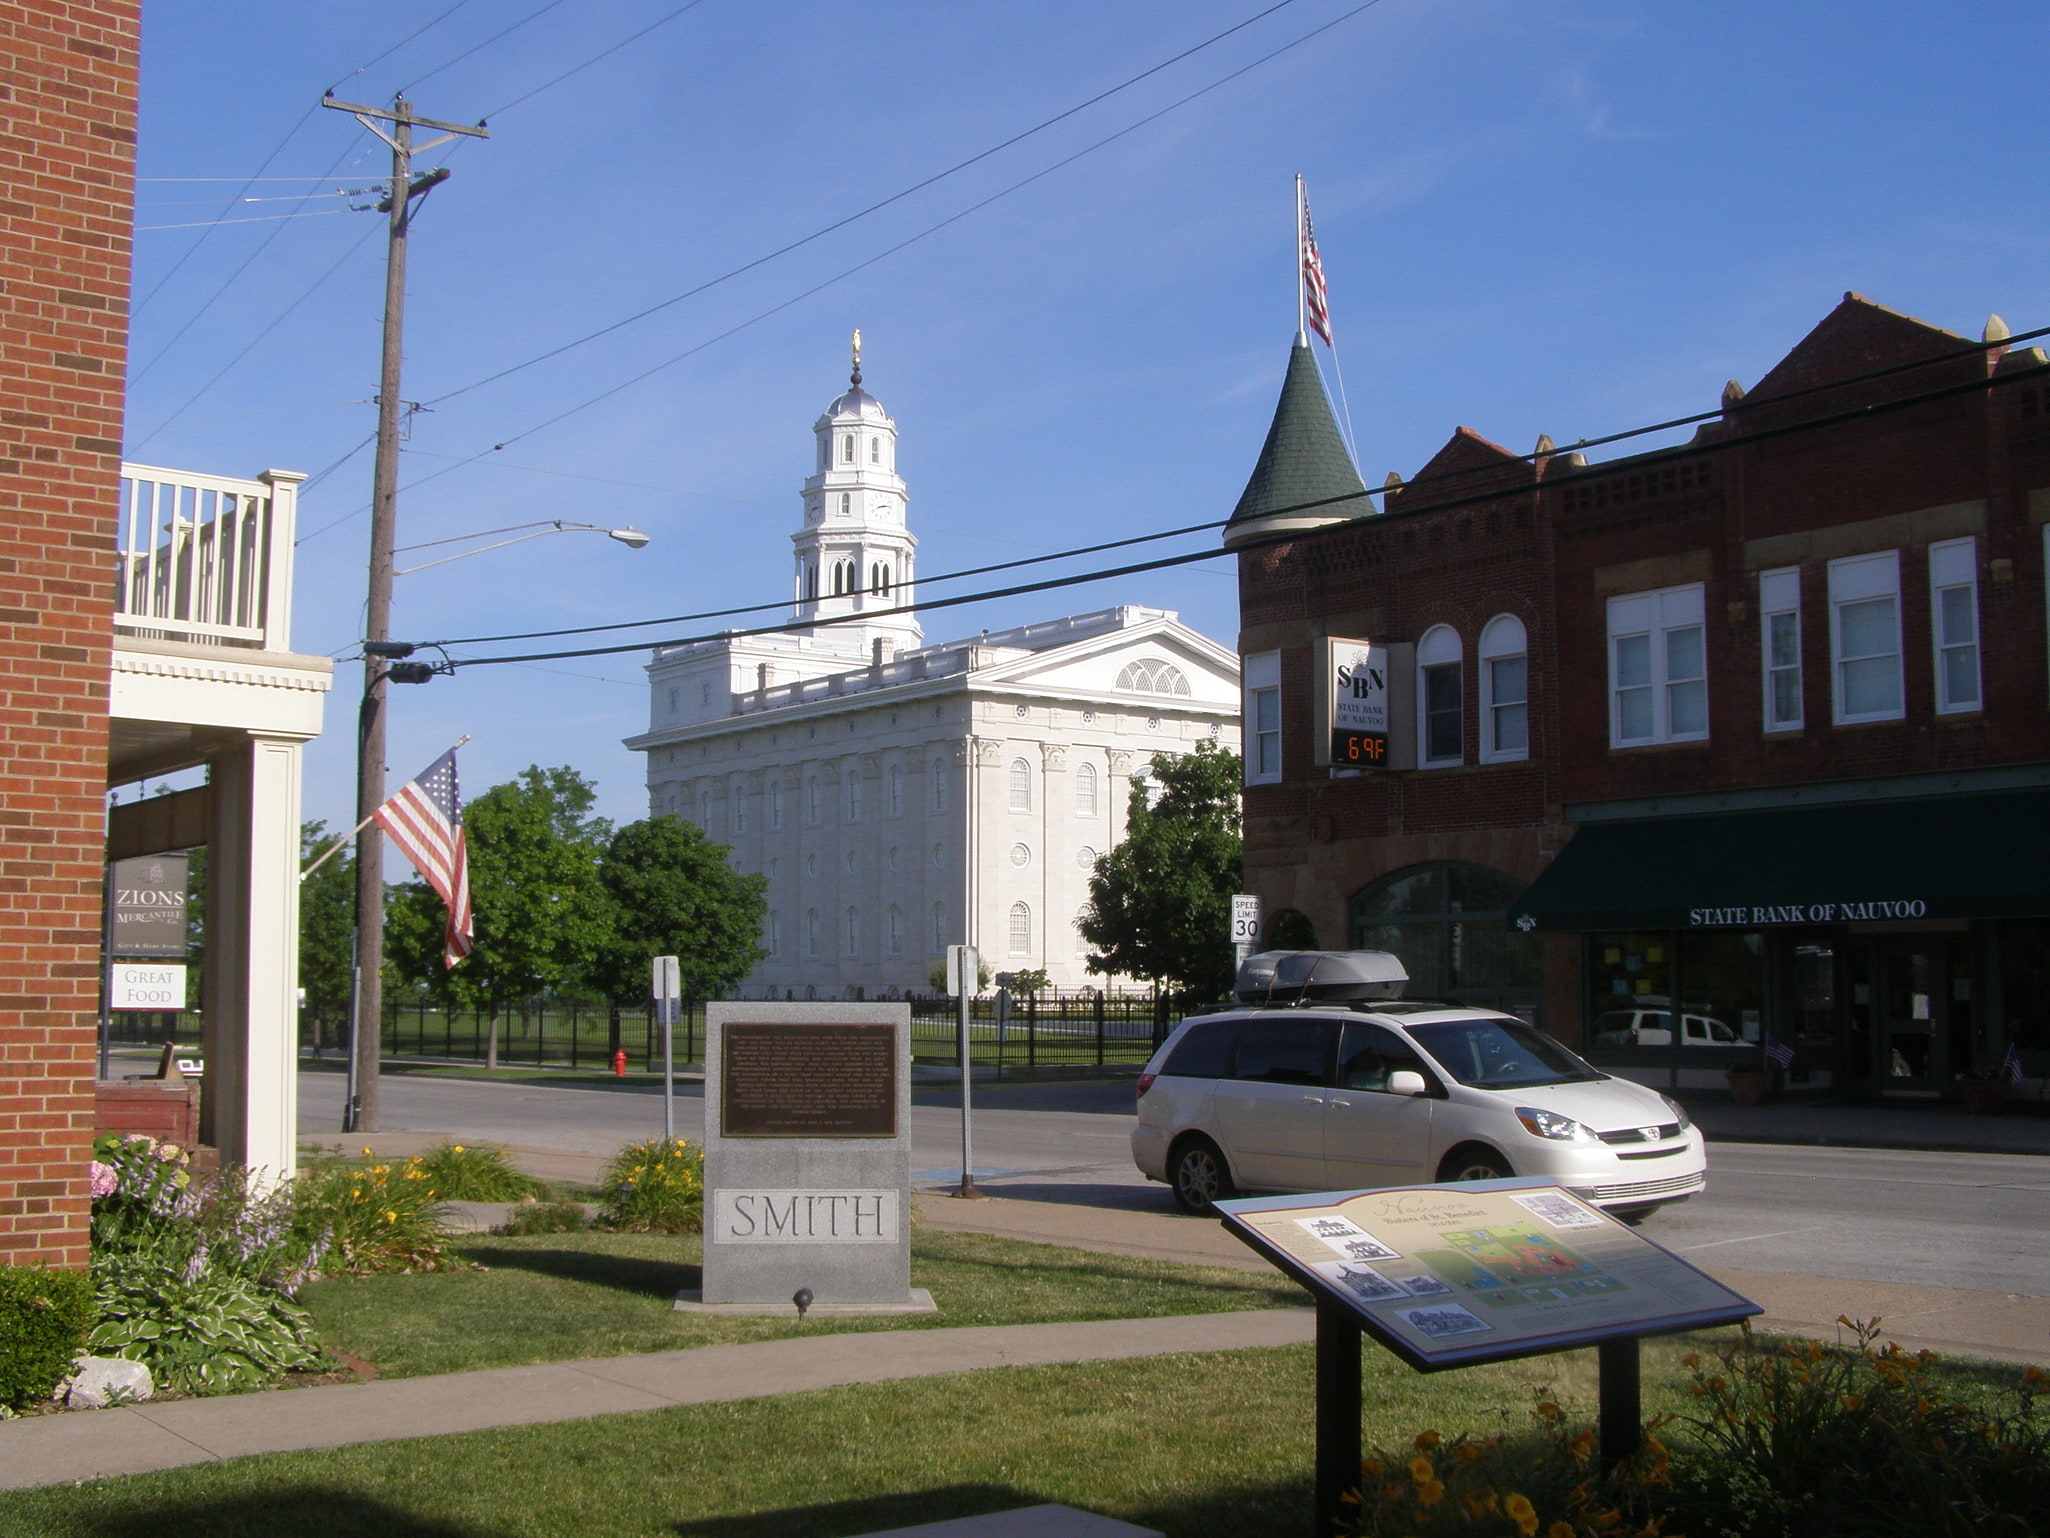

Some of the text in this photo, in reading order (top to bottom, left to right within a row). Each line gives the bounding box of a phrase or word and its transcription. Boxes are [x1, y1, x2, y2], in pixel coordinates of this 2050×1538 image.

[1338, 664, 1384, 699] SBN
[1338, 703, 1384, 715] STATE BANK
[1338, 713, 1384, 725] OF NAUVOO
[1349, 737, 1385, 760] 69F
[117, 890, 184, 906] ZIONS
[1235, 900, 1259, 910] SPEED
[117, 911, 184, 924] MERCANTILE
[1237, 911, 1257, 919] LIMIT
[1690, 899, 1927, 925] STATE BANK OF NAUVOO
[1235, 920, 1258, 937] 30
[125, 970, 174, 984] GREAT
[127, 988, 172, 1003] FOOD
[731, 1195, 883, 1236] SMITH
